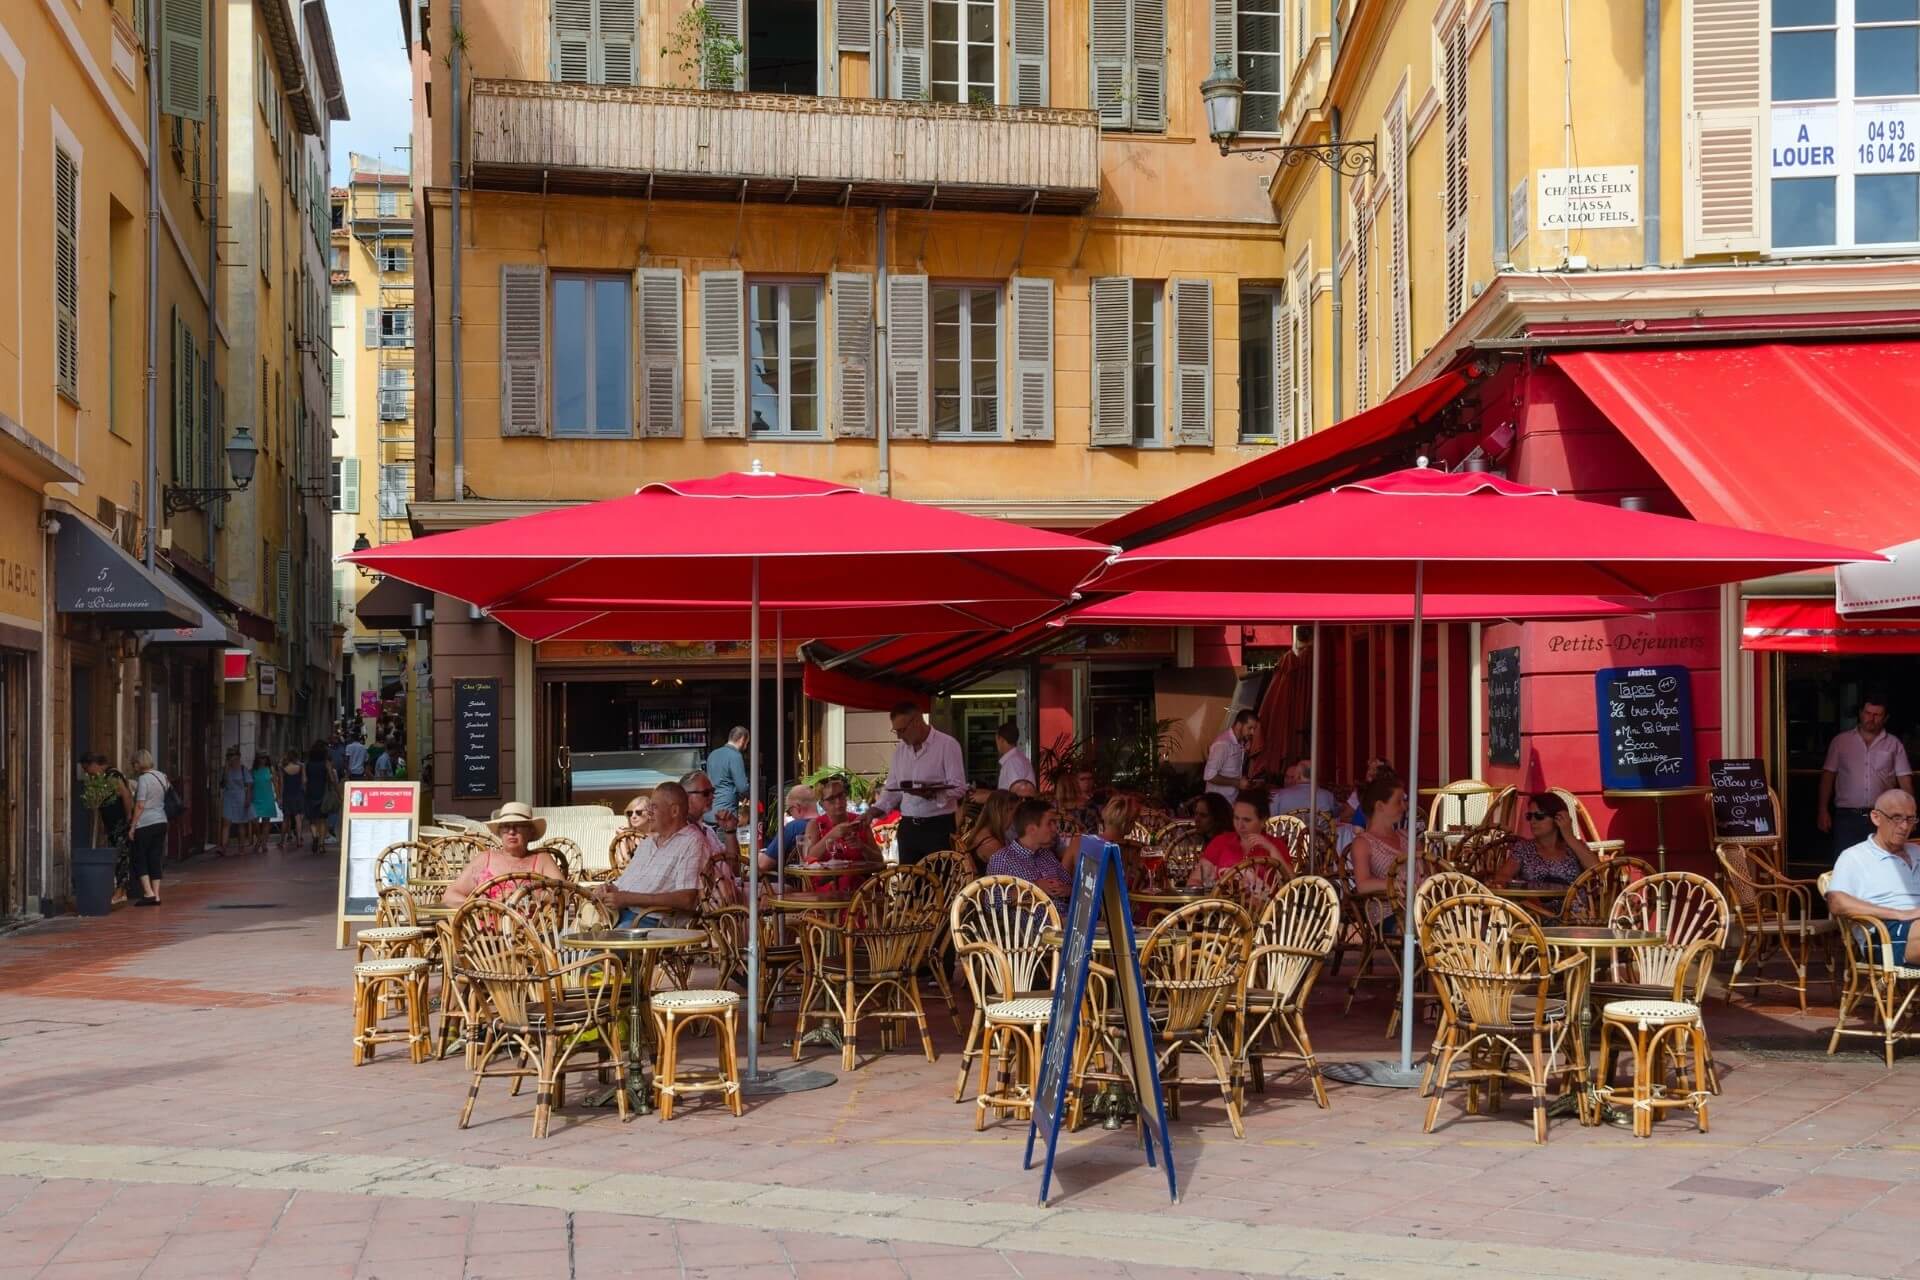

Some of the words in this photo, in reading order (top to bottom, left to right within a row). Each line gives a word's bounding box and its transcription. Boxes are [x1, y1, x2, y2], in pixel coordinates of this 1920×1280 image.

[1797, 124, 1810, 143] A
[1868, 121, 1884, 141] 04
[1888, 120, 1905, 140] 93
[1772, 146, 1835, 167] LOUER
[1858, 144, 1874, 164] 16
[1878, 143, 1895, 163] 04
[1898, 142, 1915, 162] 26
[1568, 173, 1608, 183] PLACE
[1601, 184, 1632, 194] FELIX
[1600, 211, 1629, 222] FELIS
[97, 567, 109, 581] 5
[87, 585, 102, 593] rue
[104, 581, 115, 593] de
[75, 597, 85, 609] la
[1548, 631, 1705, 657] Petits-Déjeuners
[1613, 681, 1656, 699] Tapas
[1712, 769, 1746, 788] Follow
